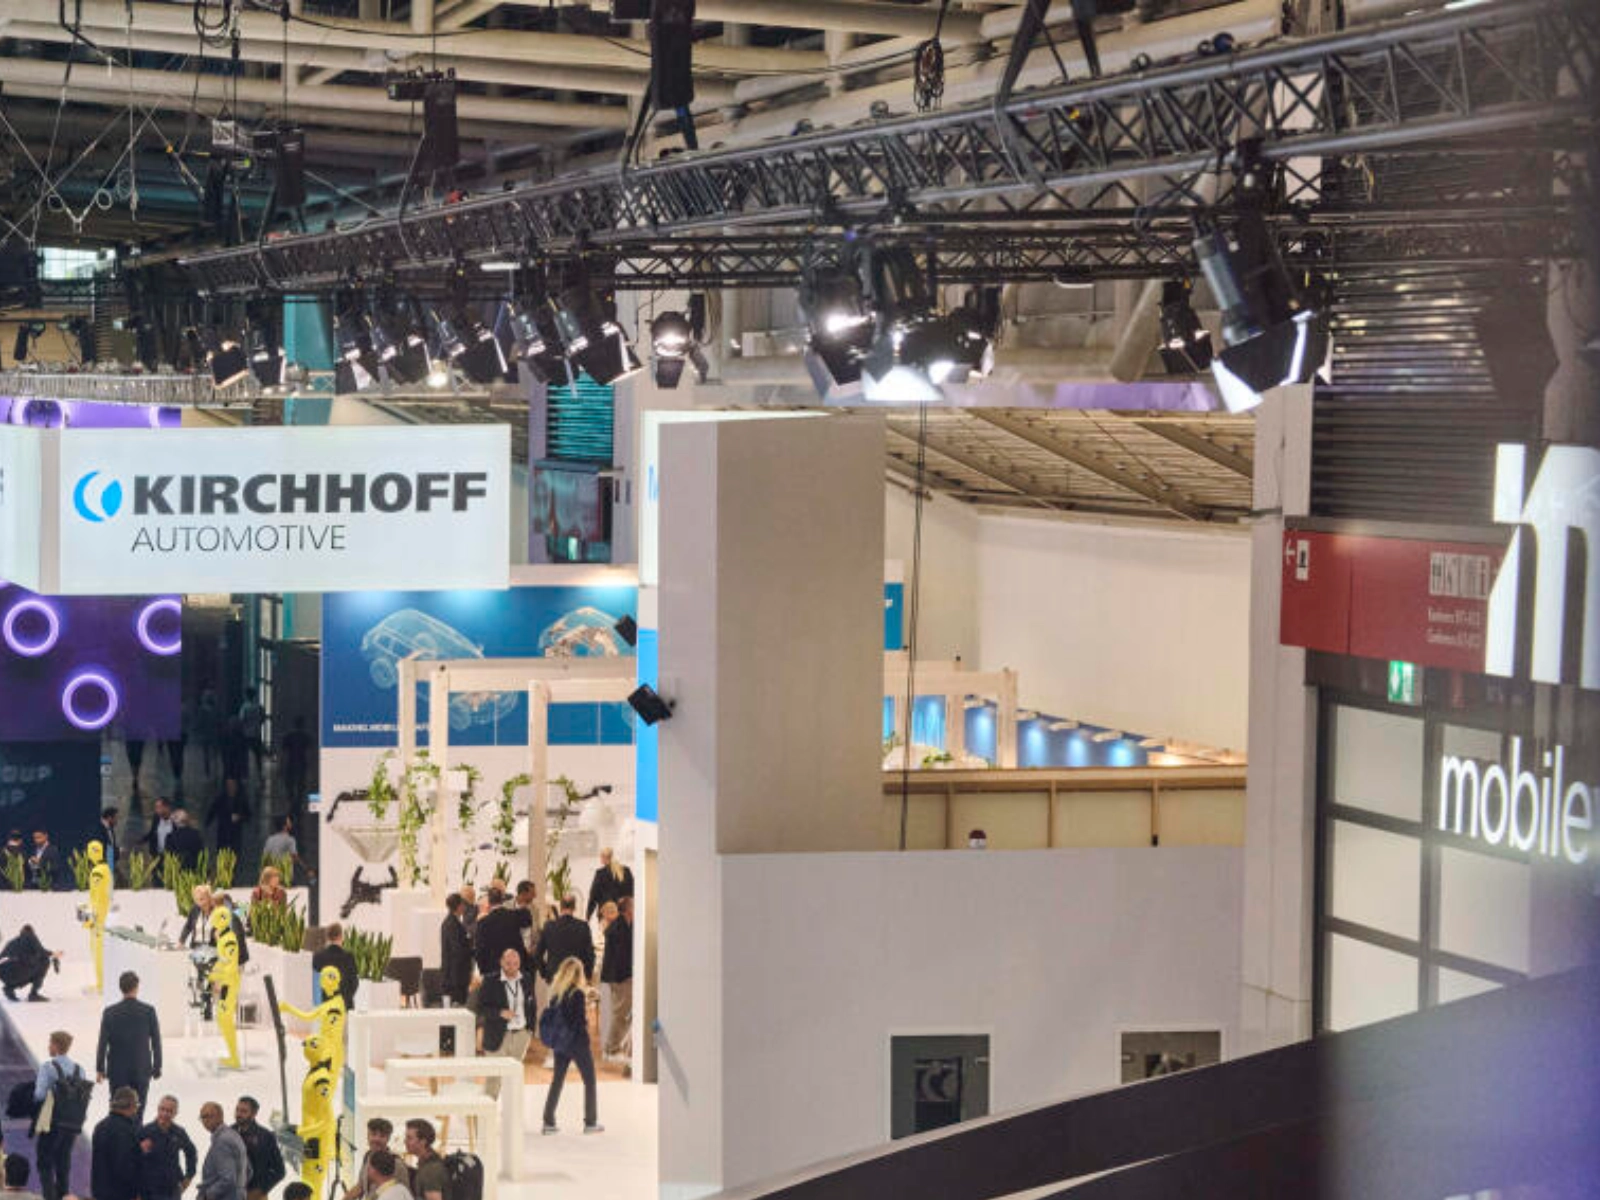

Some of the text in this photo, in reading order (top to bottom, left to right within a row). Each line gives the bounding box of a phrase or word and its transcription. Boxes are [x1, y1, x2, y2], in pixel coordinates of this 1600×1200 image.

[132, 471, 488, 515] KIRCHHOFF
[131, 524, 346, 553] AUTOMOTIVE
[1438, 734, 1593, 865] mobile
